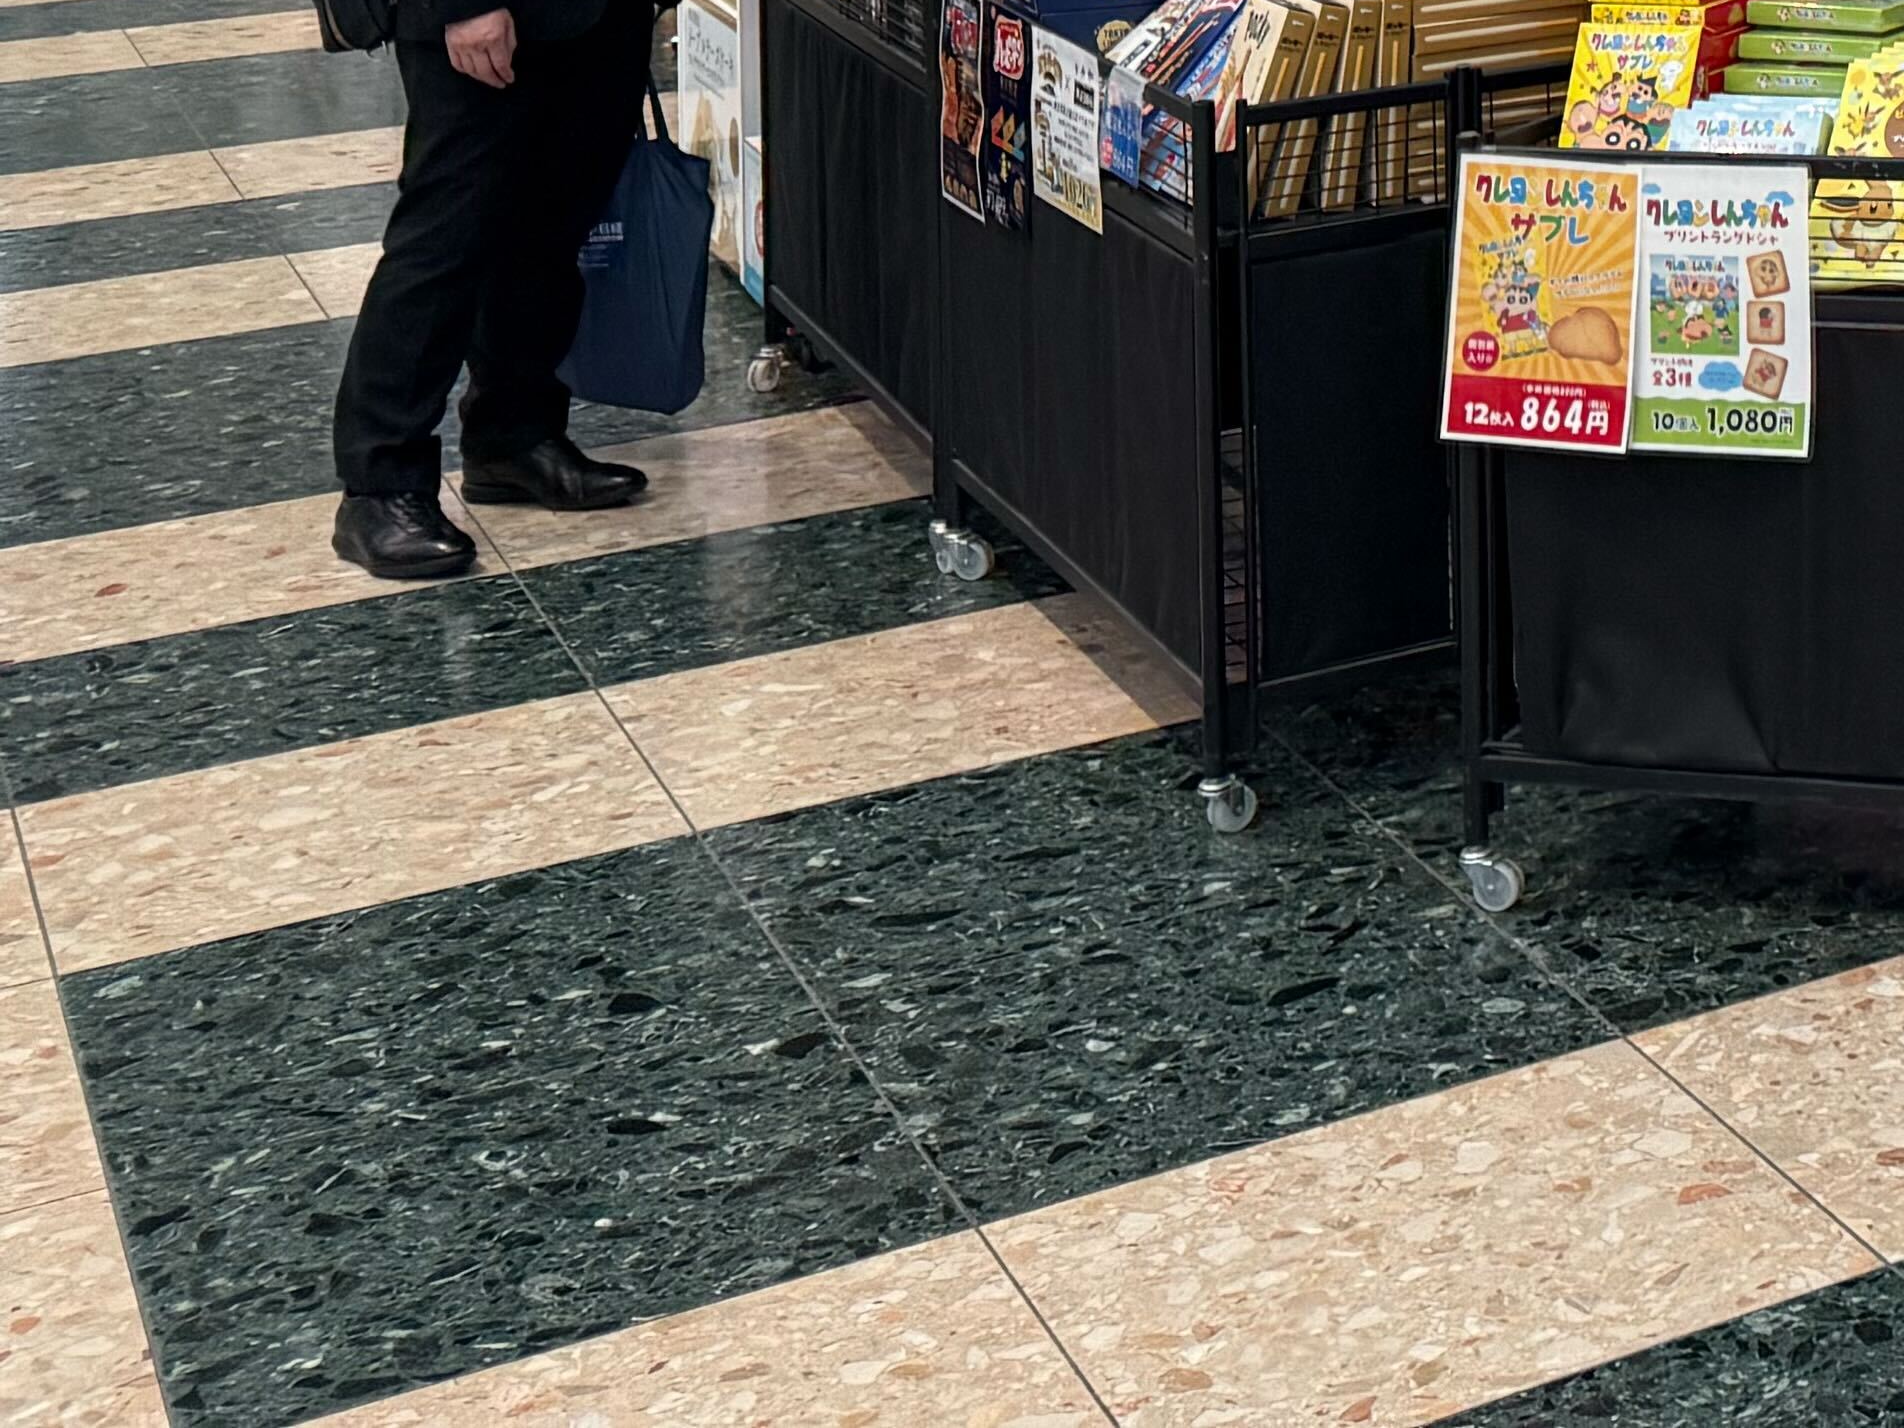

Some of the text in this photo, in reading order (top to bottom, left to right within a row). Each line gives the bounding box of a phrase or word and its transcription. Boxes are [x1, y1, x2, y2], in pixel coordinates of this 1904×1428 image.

[1511, 213, 1590, 244] サブレ
[1647, 199, 1789, 229] クレヨンしんちゃん
[1664, 230, 1779, 246] プリントラングドシャ
[1465, 396, 1608, 435] 12枚入 864円
[1707, 407, 1793, 436] 1,080円
